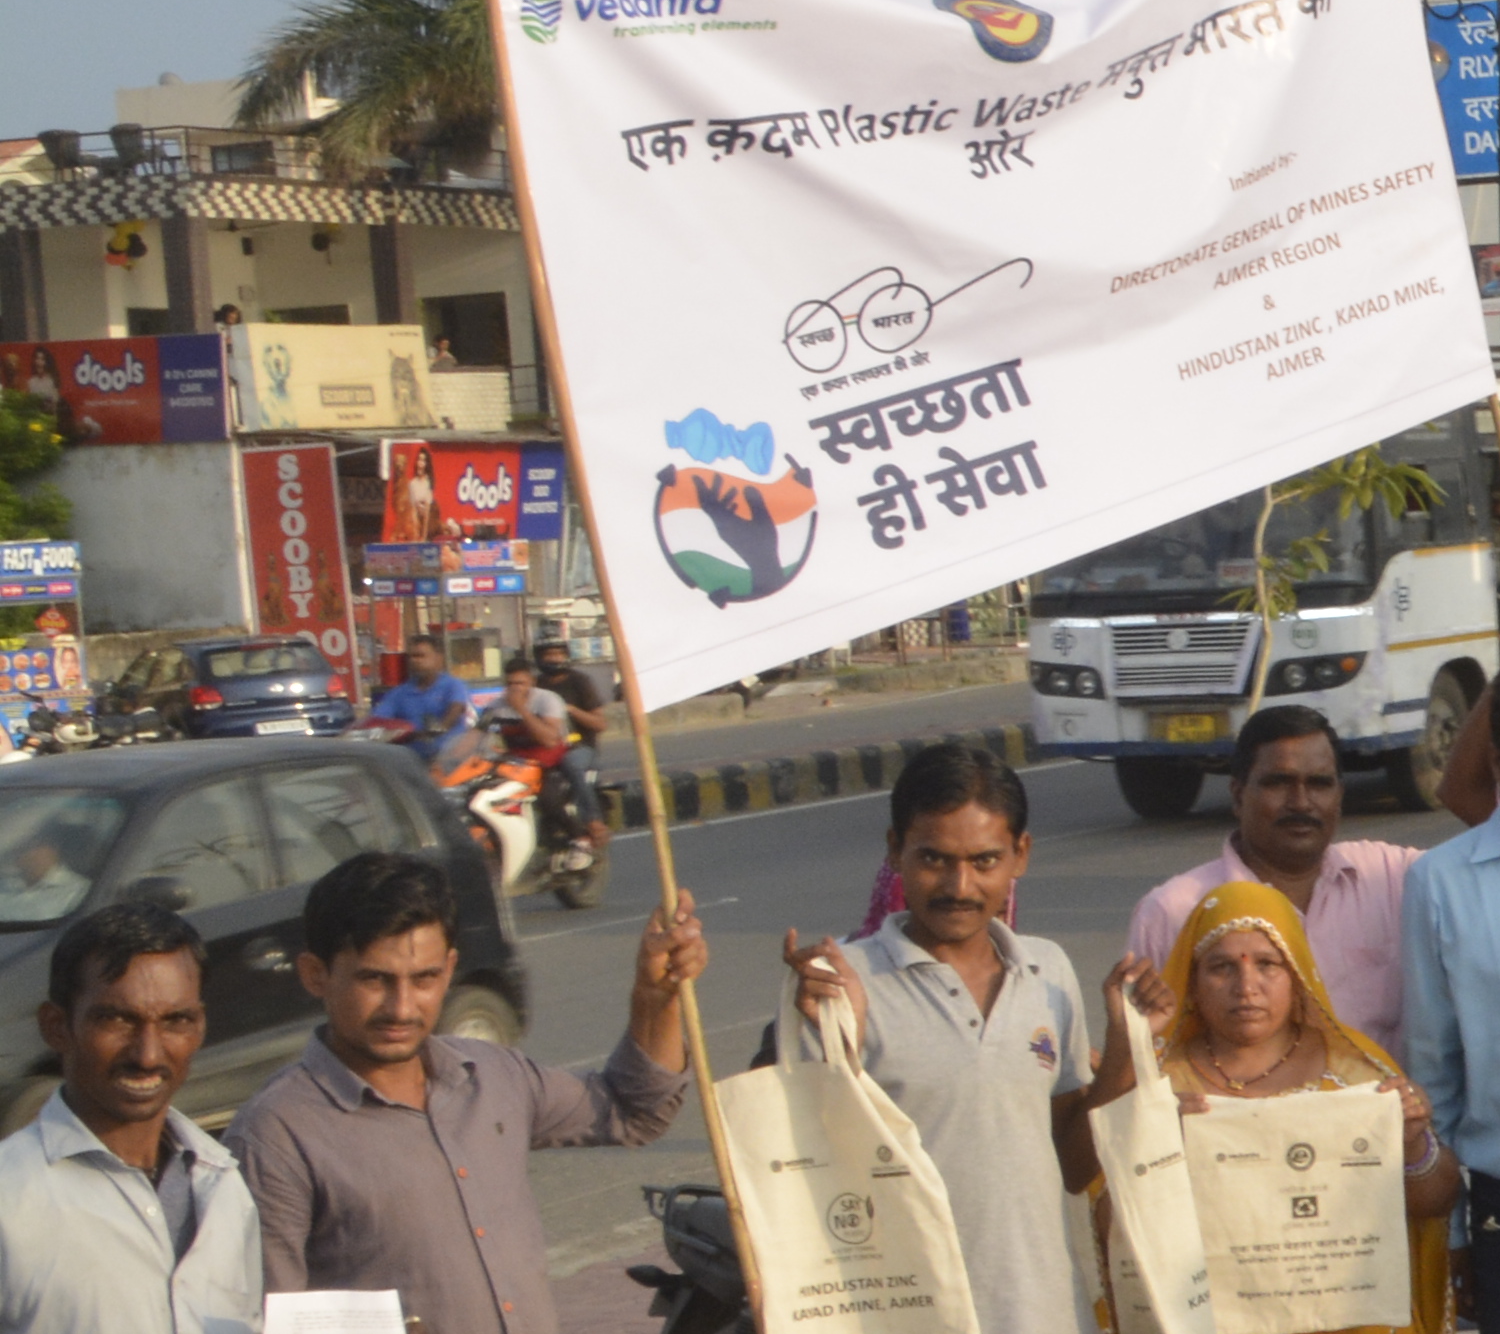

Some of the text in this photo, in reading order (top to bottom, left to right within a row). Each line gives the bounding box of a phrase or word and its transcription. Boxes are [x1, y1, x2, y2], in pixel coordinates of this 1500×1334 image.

[701, 19, 777, 33] elements
[621, 119, 694, 172] एक
[816, 100, 958, 149] Plastic
[973, 81, 1091, 128] Waste
[1229, 161, 1277, 191] Initiated
[1110, 162, 1435, 293] DIRECTORATE GENERAL OF MINES SAFETY
[1213, 232, 1342, 289] AJMER REGION
[872, 311, 916, 329] भारत
[1263, 294, 1276, 311] &
[1177, 332, 1280, 381] HINDUSTAN
[1335, 294, 1390, 326] KAYAD
[1393, 277, 1445, 306] MINE,
[75, 351, 145, 392] drools
[1266, 346, 1326, 381] AJMER
[808, 357, 1031, 464] स्वच्छता
[458, 462, 513, 511] drools
[857, 440, 1047, 549] ही सेवा
[277, 453, 314, 619] SCOOBY
[4, 546, 76, 571] FAST FOOD
[840, 1199, 862, 1212] SAY
[887, 1274, 919, 1289] ZINC
[839, 1298, 886, 1315] MINE,
[889, 1295, 934, 1310] AJMER
